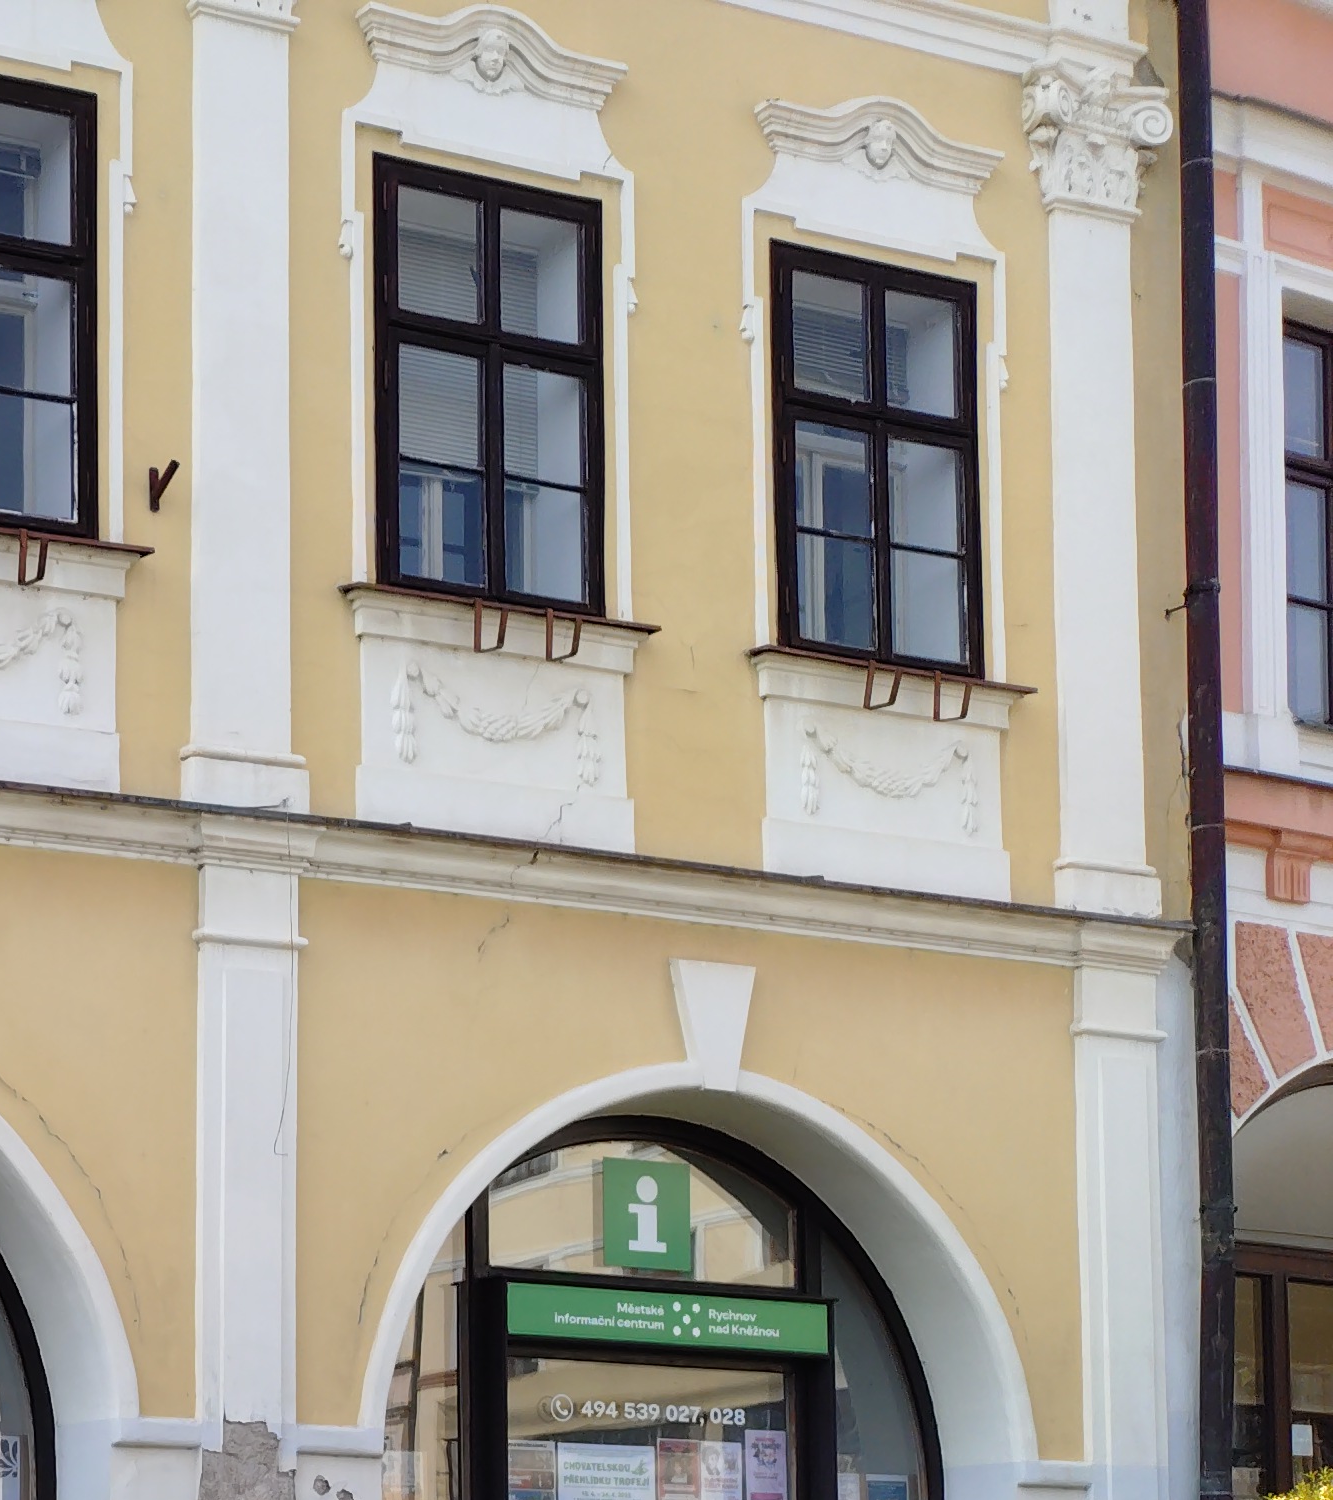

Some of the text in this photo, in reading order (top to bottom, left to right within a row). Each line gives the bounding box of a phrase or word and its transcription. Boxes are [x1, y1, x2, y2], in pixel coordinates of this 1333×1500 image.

[617, 1302, 665, 1316] Městské
[709, 1309, 757, 1323] Rychnov
[617, 1318, 665, 1331] centrum
[709, 1324, 780, 1338] nad Kněžnou
[581, 1400, 746, 1427] 494 539 027, 028
